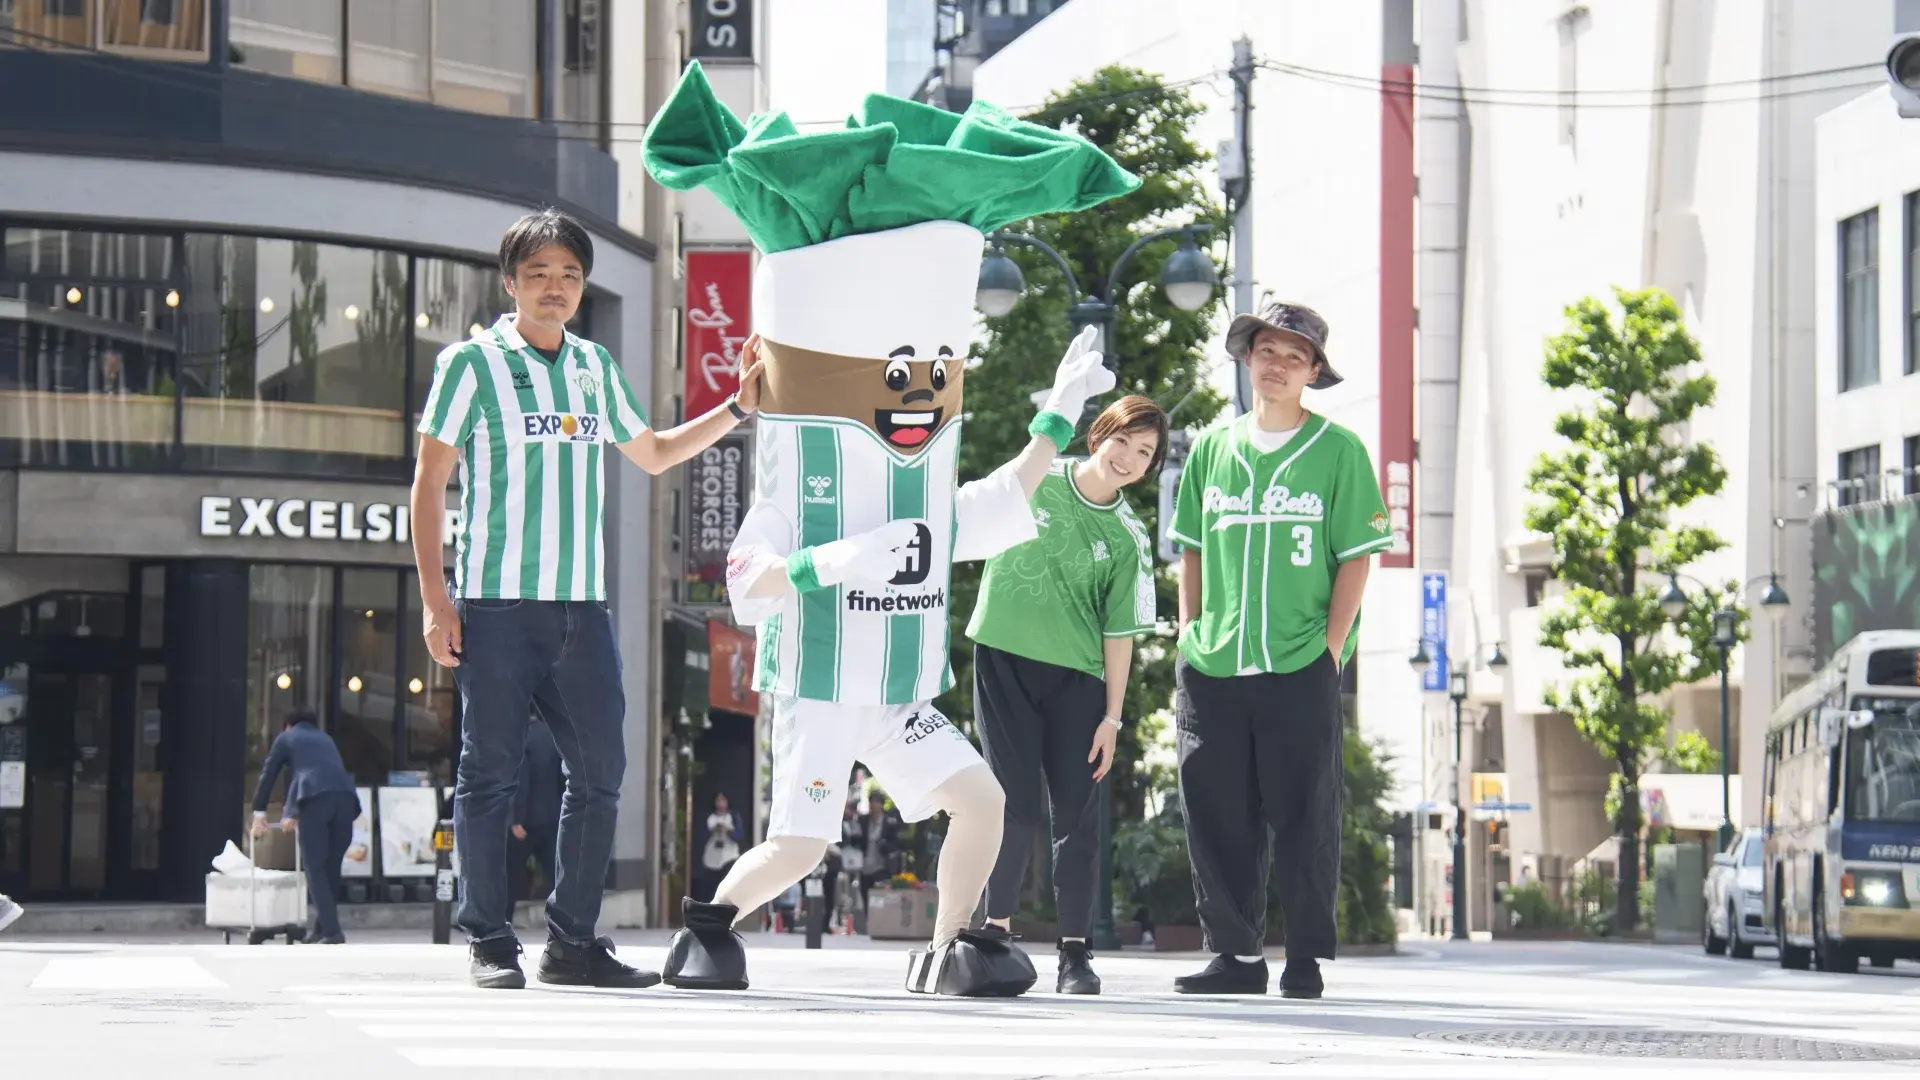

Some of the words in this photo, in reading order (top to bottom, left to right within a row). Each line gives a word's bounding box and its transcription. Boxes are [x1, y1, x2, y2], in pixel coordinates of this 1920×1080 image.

[702, 447, 722, 552] GEORGES
[804, 494, 835, 504] hummel
[1260, 486, 1323, 515] Betis
[201, 496, 461, 545] EXCELSIR
[1291, 525, 1312, 566] 3
[846, 587, 945, 612] finetwork
